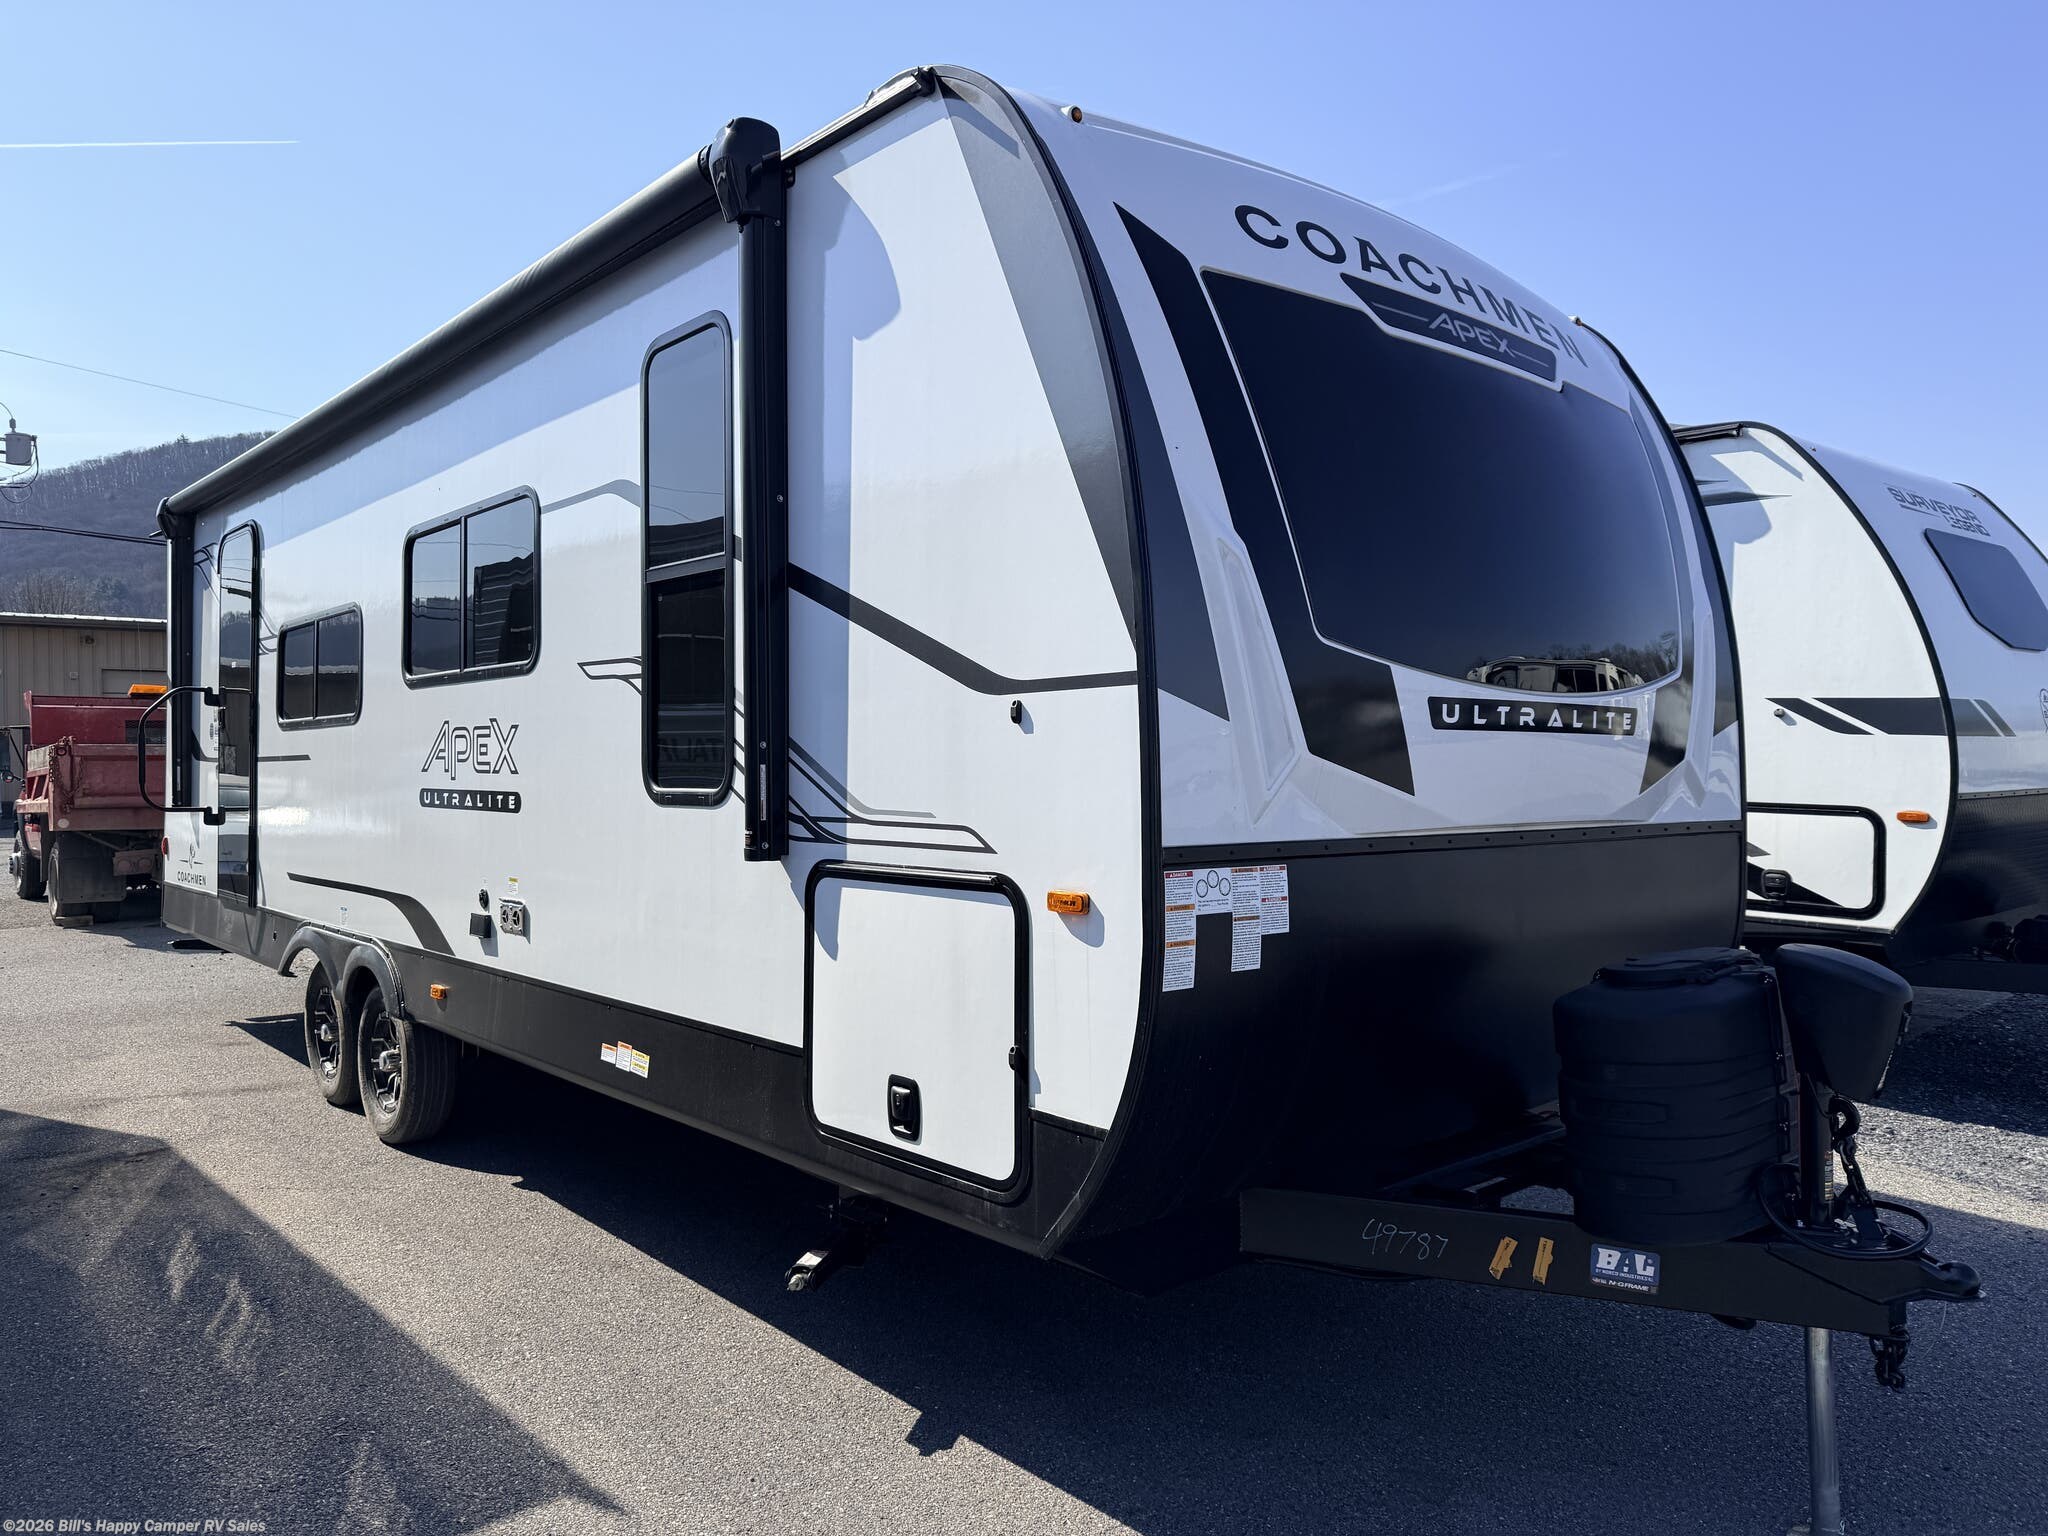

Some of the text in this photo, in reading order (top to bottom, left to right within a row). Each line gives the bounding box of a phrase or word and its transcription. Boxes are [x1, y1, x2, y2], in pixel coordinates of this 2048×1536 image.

[1235, 205, 1589, 367] COACHMEN
[1428, 313, 1514, 357] APEX
[1887, 487, 1982, 524] SURVEYOR
[1442, 703, 1633, 731] ULTRALITE
[421, 718, 519, 780] APEX
[424, 792, 516, 809] ULTRALITE
[177, 871, 207, 886] COACHMEN
[1362, 1218, 1449, 1261] 49787
[1596, 1248, 1655, 1276] BAL
